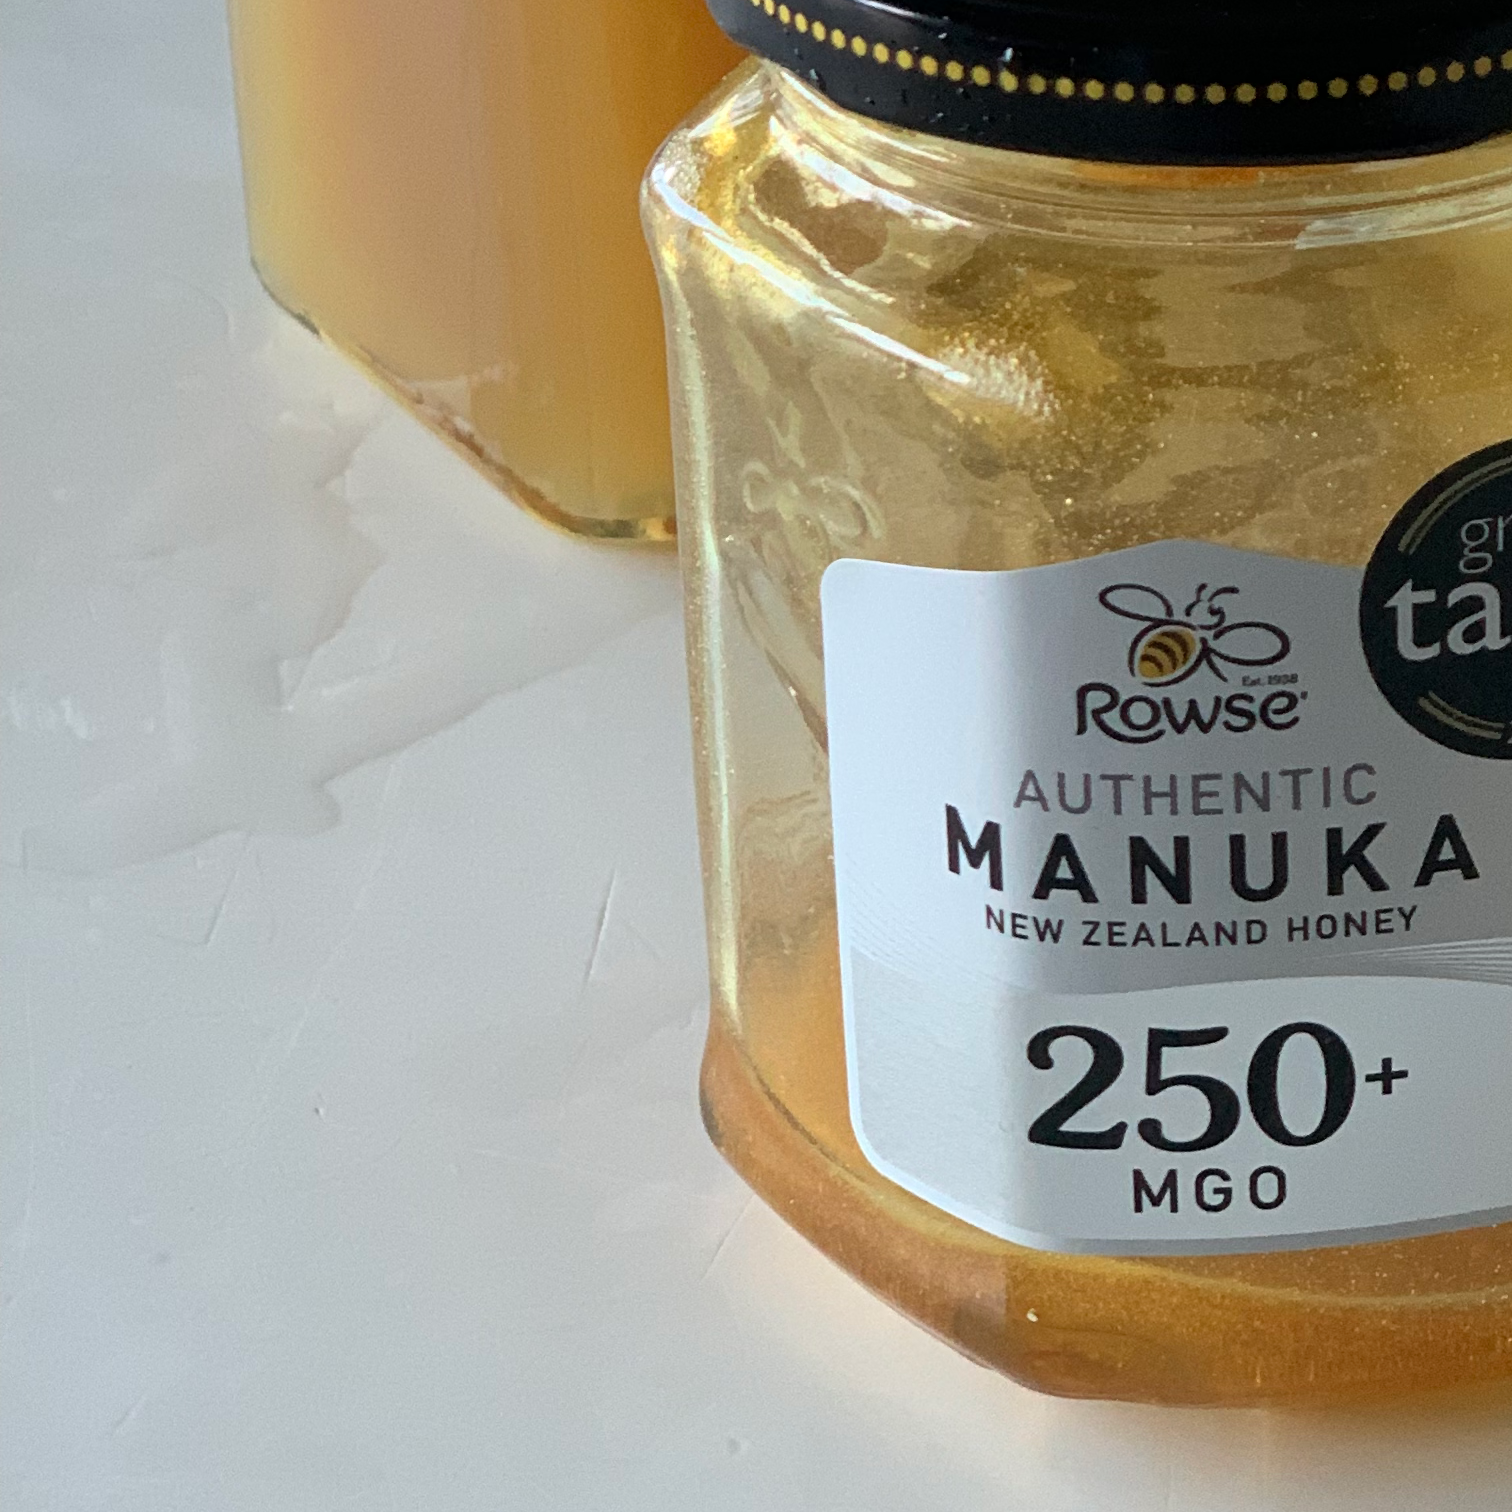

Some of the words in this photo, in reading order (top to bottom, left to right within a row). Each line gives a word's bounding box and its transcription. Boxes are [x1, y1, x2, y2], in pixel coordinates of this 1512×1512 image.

[1075, 681, 1300, 745] Rowse
[1012, 761, 1378, 817] AUTHENTIC
[944, 802, 1481, 906] MANUKA
[984, 903, 1064, 945] NEW
[1081, 919, 1268, 948] ZEALAND
[1287, 904, 1418, 943] HONEY
[1026, 1020, 1410, 1153] 250+
[1131, 1164, 1288, 1214] MGO
